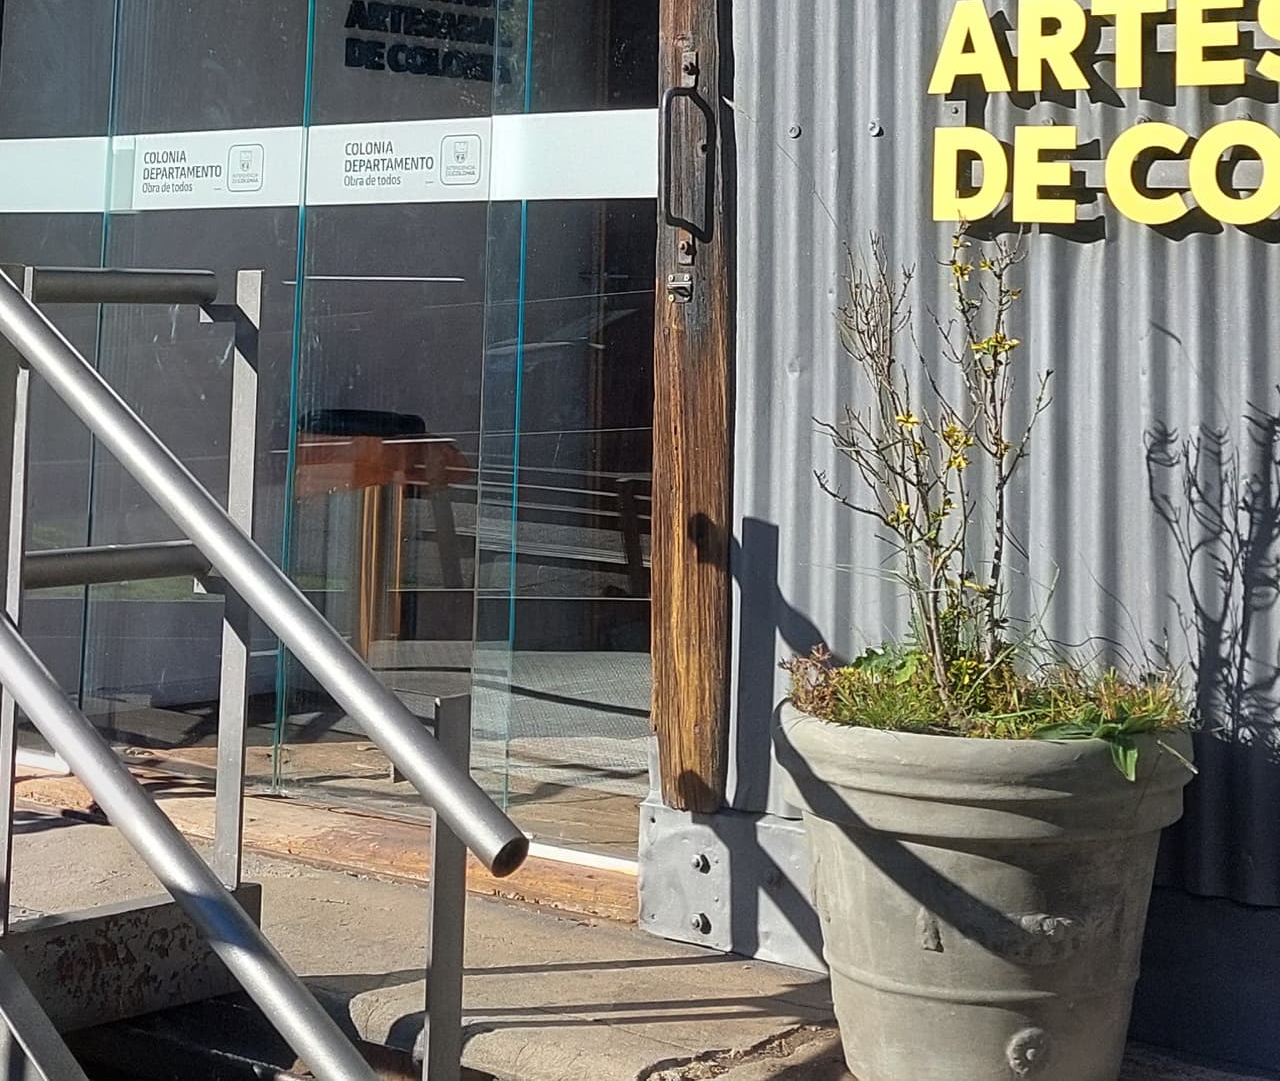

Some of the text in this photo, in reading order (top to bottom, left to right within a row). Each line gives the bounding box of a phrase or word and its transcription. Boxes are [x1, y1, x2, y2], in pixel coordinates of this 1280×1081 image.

[345, 141, 394, 156] COLONIA
[143, 150, 187, 164] COLONIA
[344, 156, 434, 173] DEPARTAMENTO
[143, 165, 222, 181] DEPARTAMENTO
[343, 174, 401, 186] Obra de todos
[931, 124, 1078, 225] DE
[142, 181, 193, 193] Obra de todos
